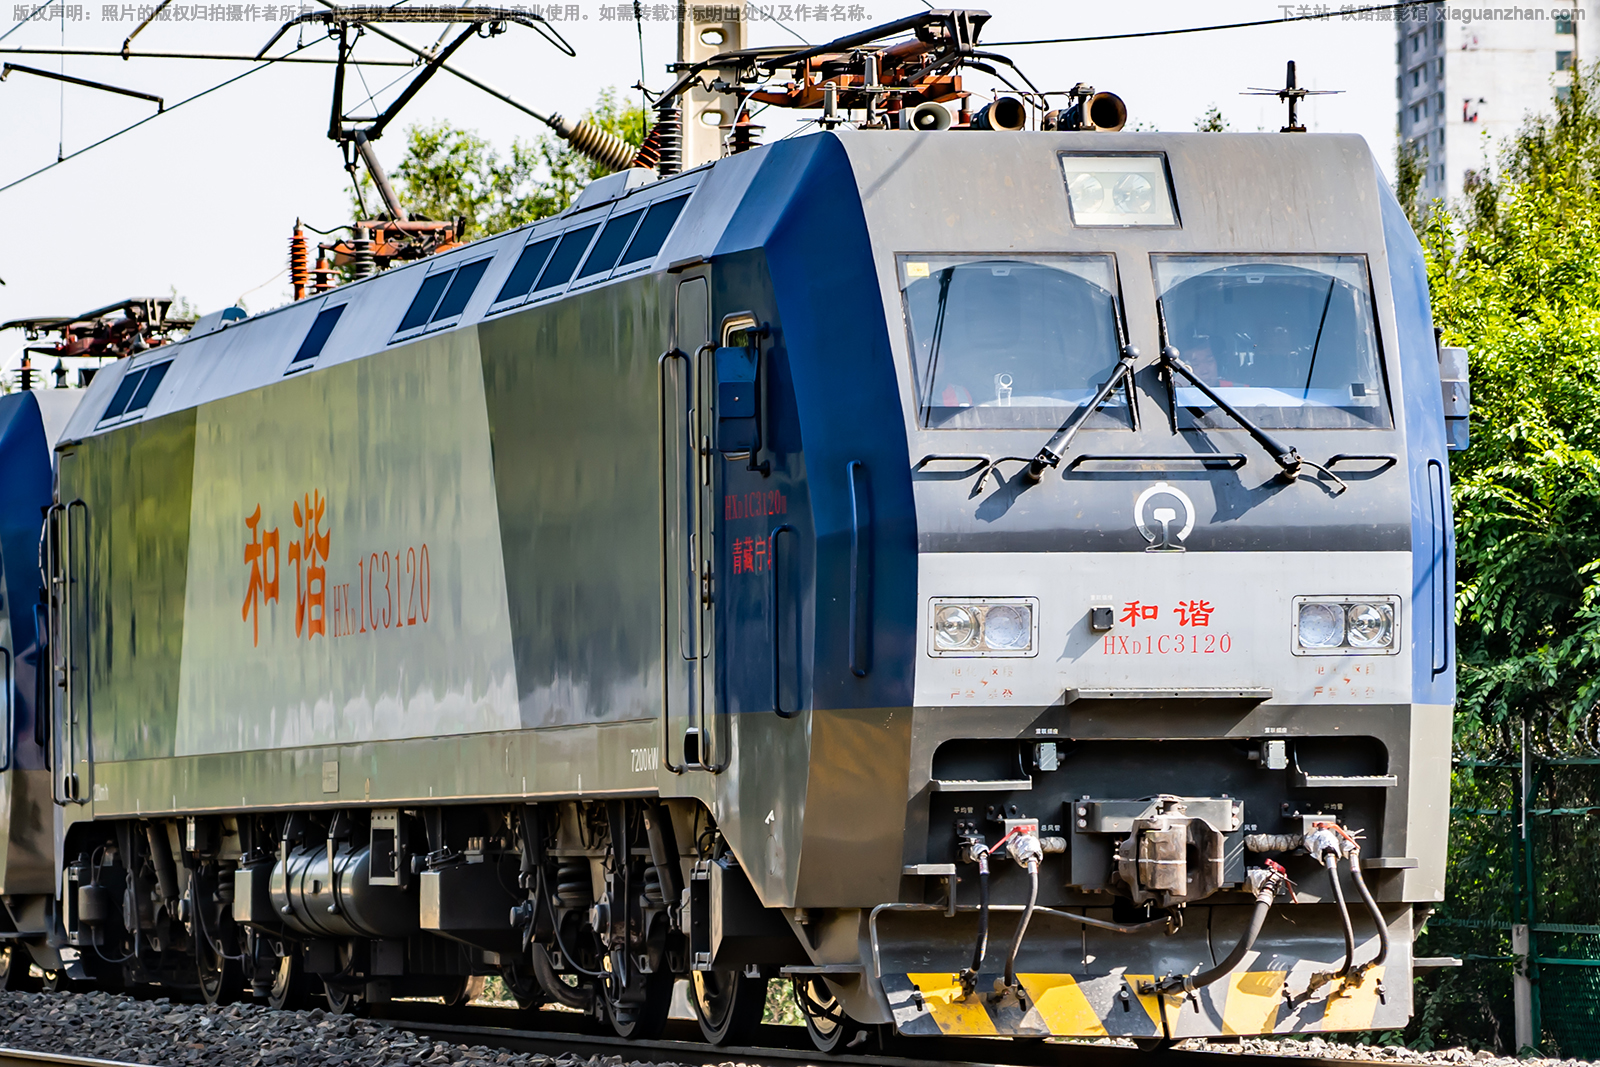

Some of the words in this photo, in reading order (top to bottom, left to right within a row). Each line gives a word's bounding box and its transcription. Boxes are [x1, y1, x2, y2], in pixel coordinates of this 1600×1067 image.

[241, 488, 331, 648] 和谐
[1119, 599, 1215, 628] 和谐
[1103, 634, 1232, 655] HXD1C3120
[630, 747, 659, 773] 7200kW
[953, 806, 974, 814] 平均管
[1040, 824, 1061, 832] 总风管
